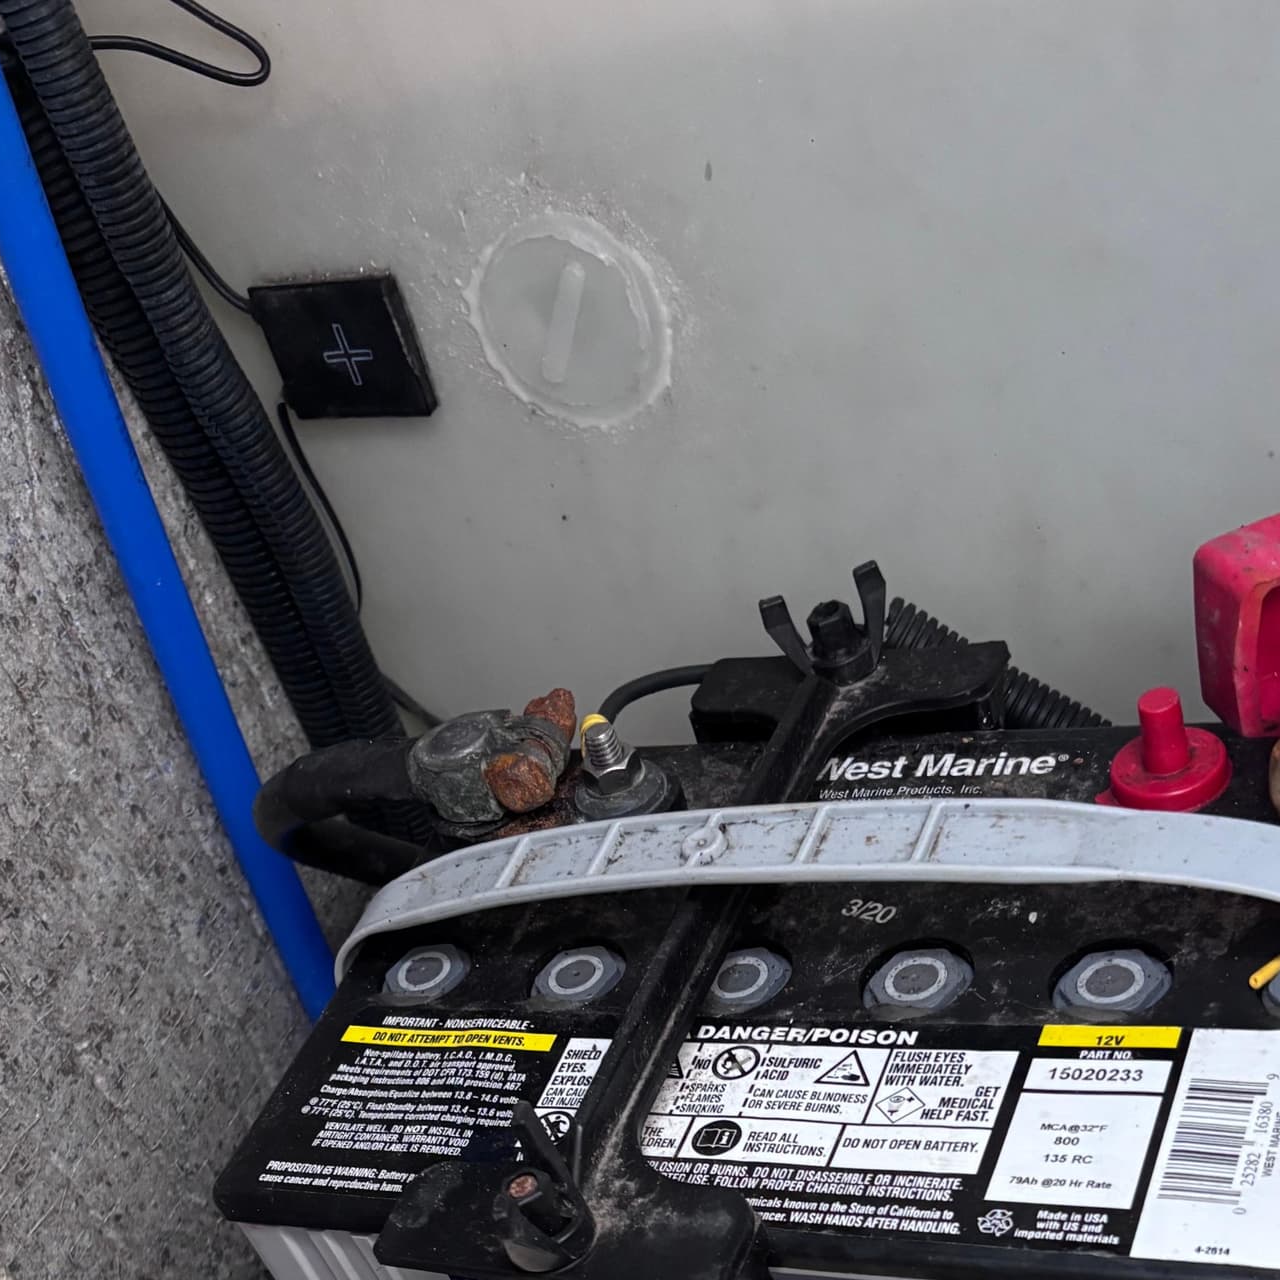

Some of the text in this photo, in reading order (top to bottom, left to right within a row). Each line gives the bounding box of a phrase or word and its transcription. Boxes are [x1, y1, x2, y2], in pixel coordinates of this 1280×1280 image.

[841, 899, 897, 925] 3/20
[382, 1016, 529, 1030] IMPORTANT NONSERVICEABLE
[373, 1031, 525, 1046] DO NOT ATTEMPT TO OPEN VENTS.
[697, 1025, 918, 1046] DANGER/POISON
[1095, 1035, 1125, 1046] 12V
[564, 1049, 602, 1060] SHIELD
[893, 1051, 966, 1063] FLUSH EYES
[1080, 1050, 1133, 1060] PART NO.
[558, 1062, 586, 1073] EYES.
[695, 1058, 711, 1070] NO
[766, 1056, 823, 1070] SULFURIC
[888, 1063, 973, 1075] IMMEDIATELY
[551, 1075, 592, 1087] EXPLOS
[760, 1069, 789, 1081] ACID
[884, 1075, 964, 1087] WITH WATER.
[1048, 1067, 1144, 1082] 15020233
[546, 1087, 586, 1098] CAN CAU
[753, 1087, 868, 1104] CAN CAUSE BLINDNESS
[975, 1086, 1001, 1097] GET
[541, 1097, 583, 1107] OR INJUR
[748, 1098, 843, 1114] OR SEVERE BURNS.
[938, 1097, 994, 1110] MEDICAL
[920, 1109, 989, 1122] HELP FAST.
[325, 1121, 364, 1132] VENTILATE
[391, 1124, 403, 1133] DO
[404, 1125, 428, 1134] NOT
[428, 1126, 462, 1137] INSTALL
[463, 1129, 473, 1138] IN
[644, 1126, 664, 1137] THE
[317, 1130, 469, 1147] AIRTIGHT CONTAINER. WARRANTY VOID
[641, 1137, 677, 1149] LDREN.
[748, 1131, 799, 1144] READ ALL
[1054, 1137, 1080, 1146] 800
[1240, 1153, 1261, 1186] 25282
[1253, 1101, 1274, 1134] 16380
[312, 1138, 321, 1147] IF
[321, 1139, 352, 1149] OPENED
[384, 1142, 408, 1152] LABEL
[410, 1143, 420, 1153] IS
[420, 1144, 462, 1156] REMOVED.
[743, 1142, 826, 1158] INSTRUCTIONS.
[842, 1138, 979, 1153] DO NOT OPEN BATTERY.
[1043, 1154, 1094, 1164] 135 RC
[1261, 1150, 1277, 1178] WEST
[266, 1160, 321, 1175] PROPOSITION
[333, 1166, 378, 1179] WARNING:
[378, 1169, 408, 1182] Battery
[693, 1162, 710, 1174] OR
[710, 1163, 748, 1177] BURNS.
[753, 1167, 769, 1178] DO
[770, 1168, 795, 1180] NOT
[795, 1169, 873, 1185] DISASSEMBLE
[874, 1174, 891, 1186] OR
[892, 1175, 963, 1190] INCINERATE.
[259, 1173, 284, 1184] cause
[284, 1176, 312, 1186] cancer
[312, 1177, 328, 1187] and
[380, 1182, 403, 1193] harm.
[713, 1177, 759, 1190] FOLLOW
[760, 1179, 804, 1192] PROPER
[805, 1181, 866, 1196] CHARGING
[865, 1185, 954, 1201] INSTRUCTIONS.
[1009, 1175, 1112, 1189] 79Ah @20 Hr Rate
[746, 1195, 954, 1220] micals known to the State of California to
[760, 1211, 961, 1235] ncer. WASH HANDS AFTER HANDLING.
[1037, 1210, 1108, 1223] Made in USA
[1036, 1220, 1103, 1233] with US and
[1014, 1228, 1119, 1245] imported materials
